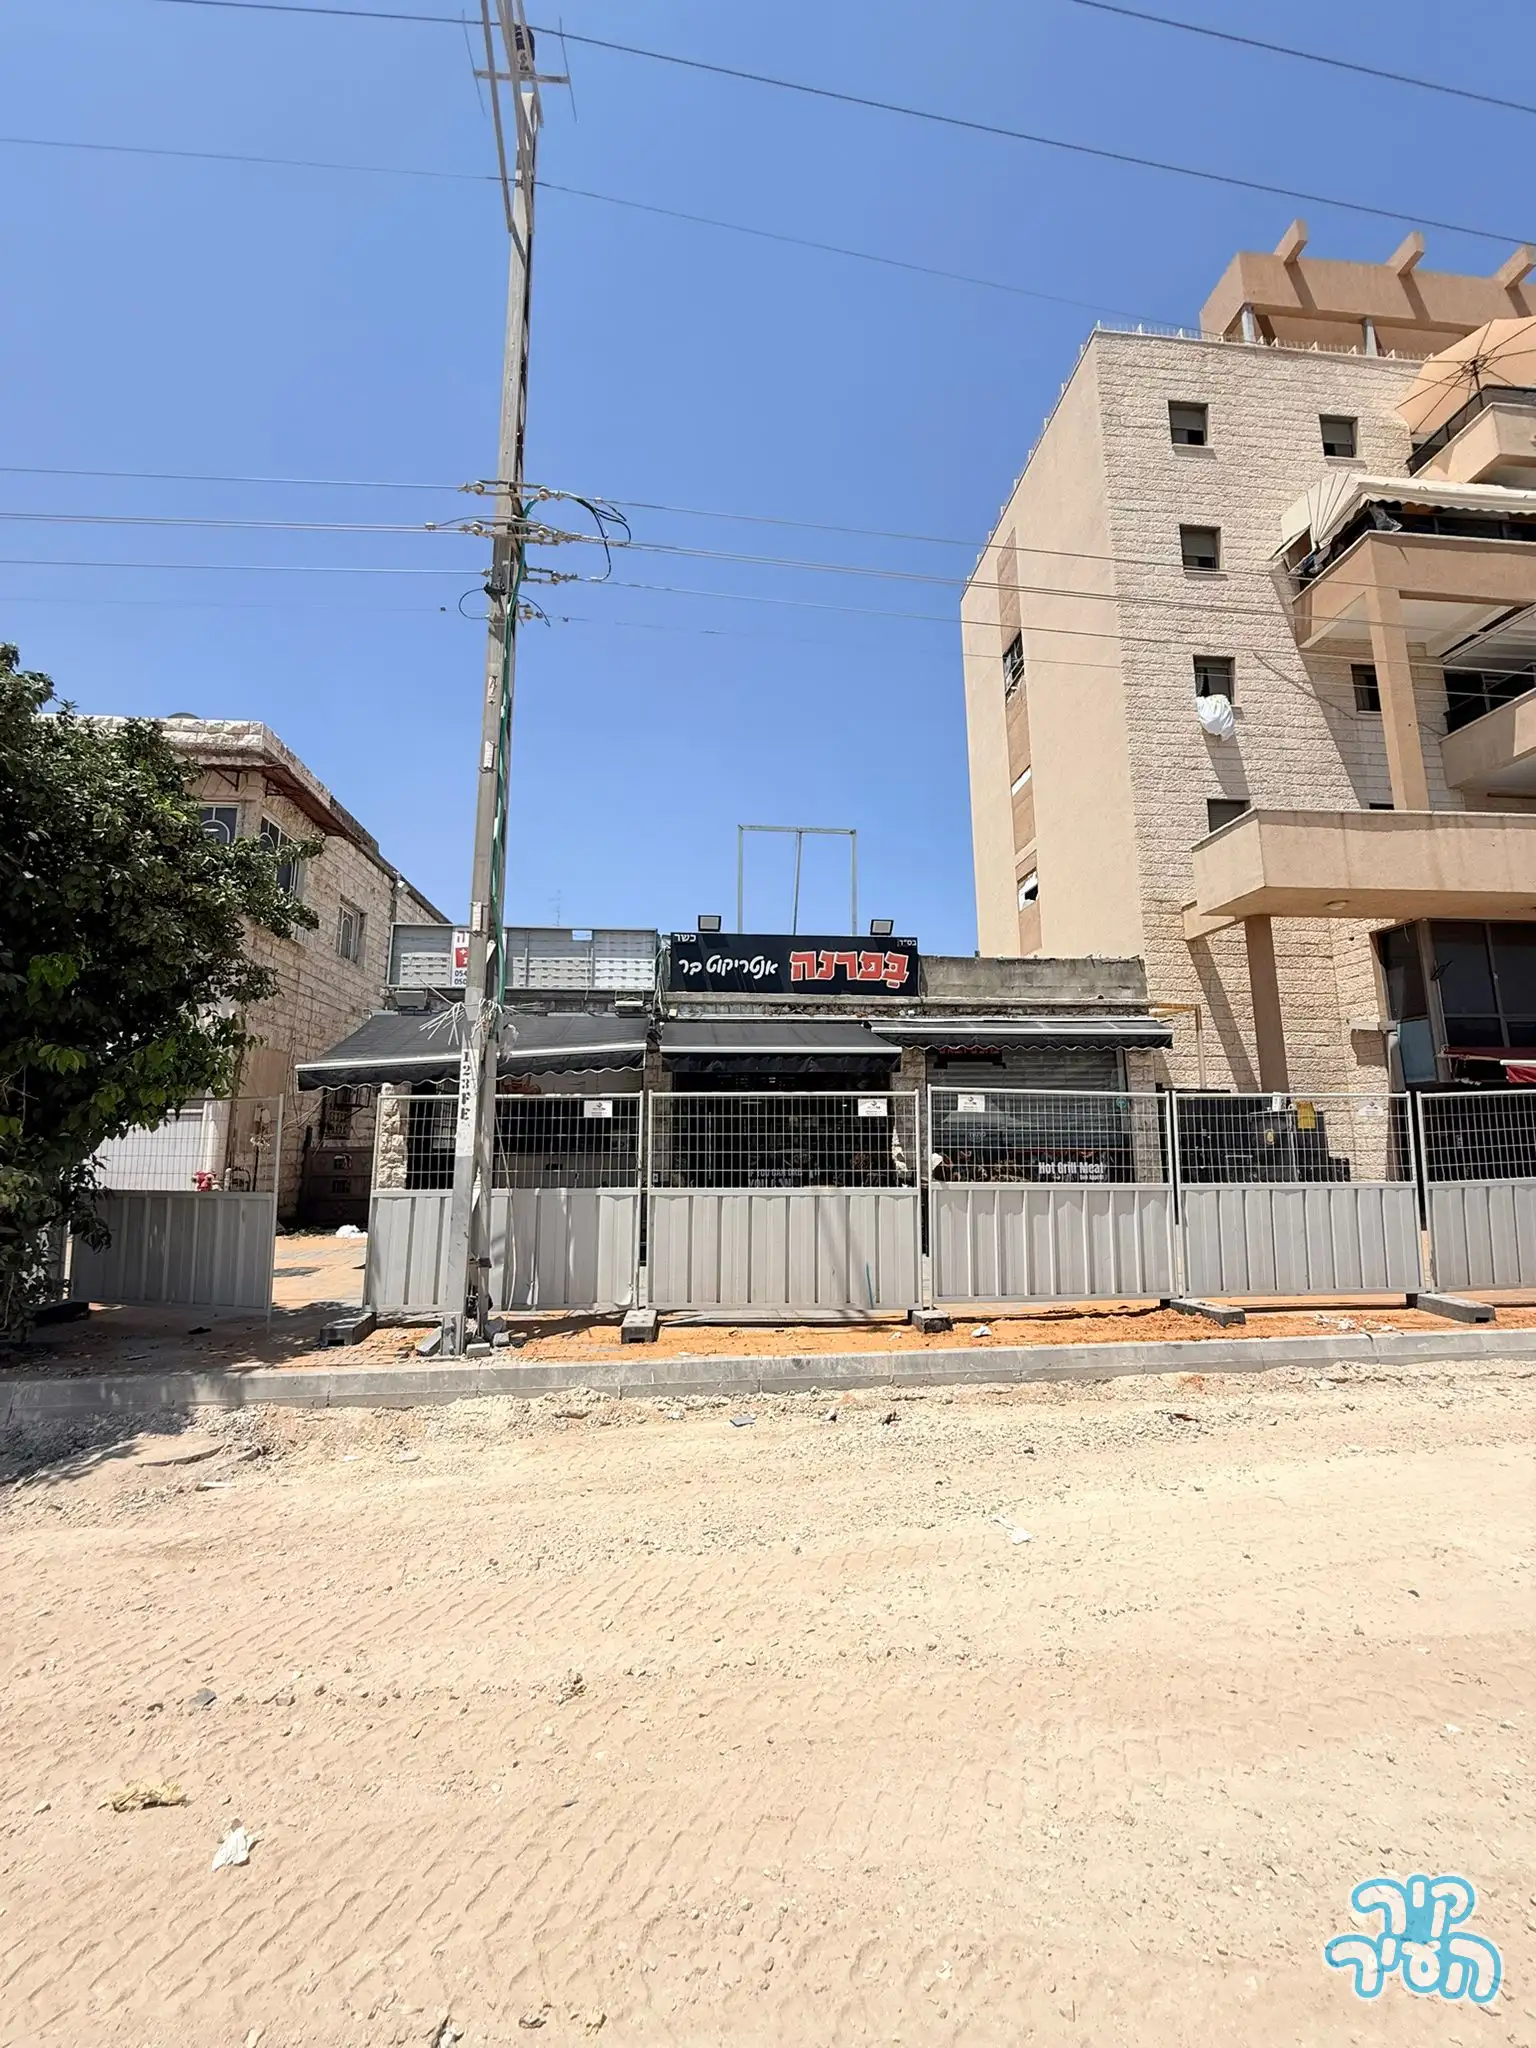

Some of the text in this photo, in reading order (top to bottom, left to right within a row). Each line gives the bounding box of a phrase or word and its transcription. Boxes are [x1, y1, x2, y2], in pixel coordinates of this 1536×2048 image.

[674, 933, 697, 943] כשר
[678, 959, 703, 976] בר
[705, 954, 779, 980] אנטריקוט
[1038, 1161, 1104, 1174] Hot Grill Meat
